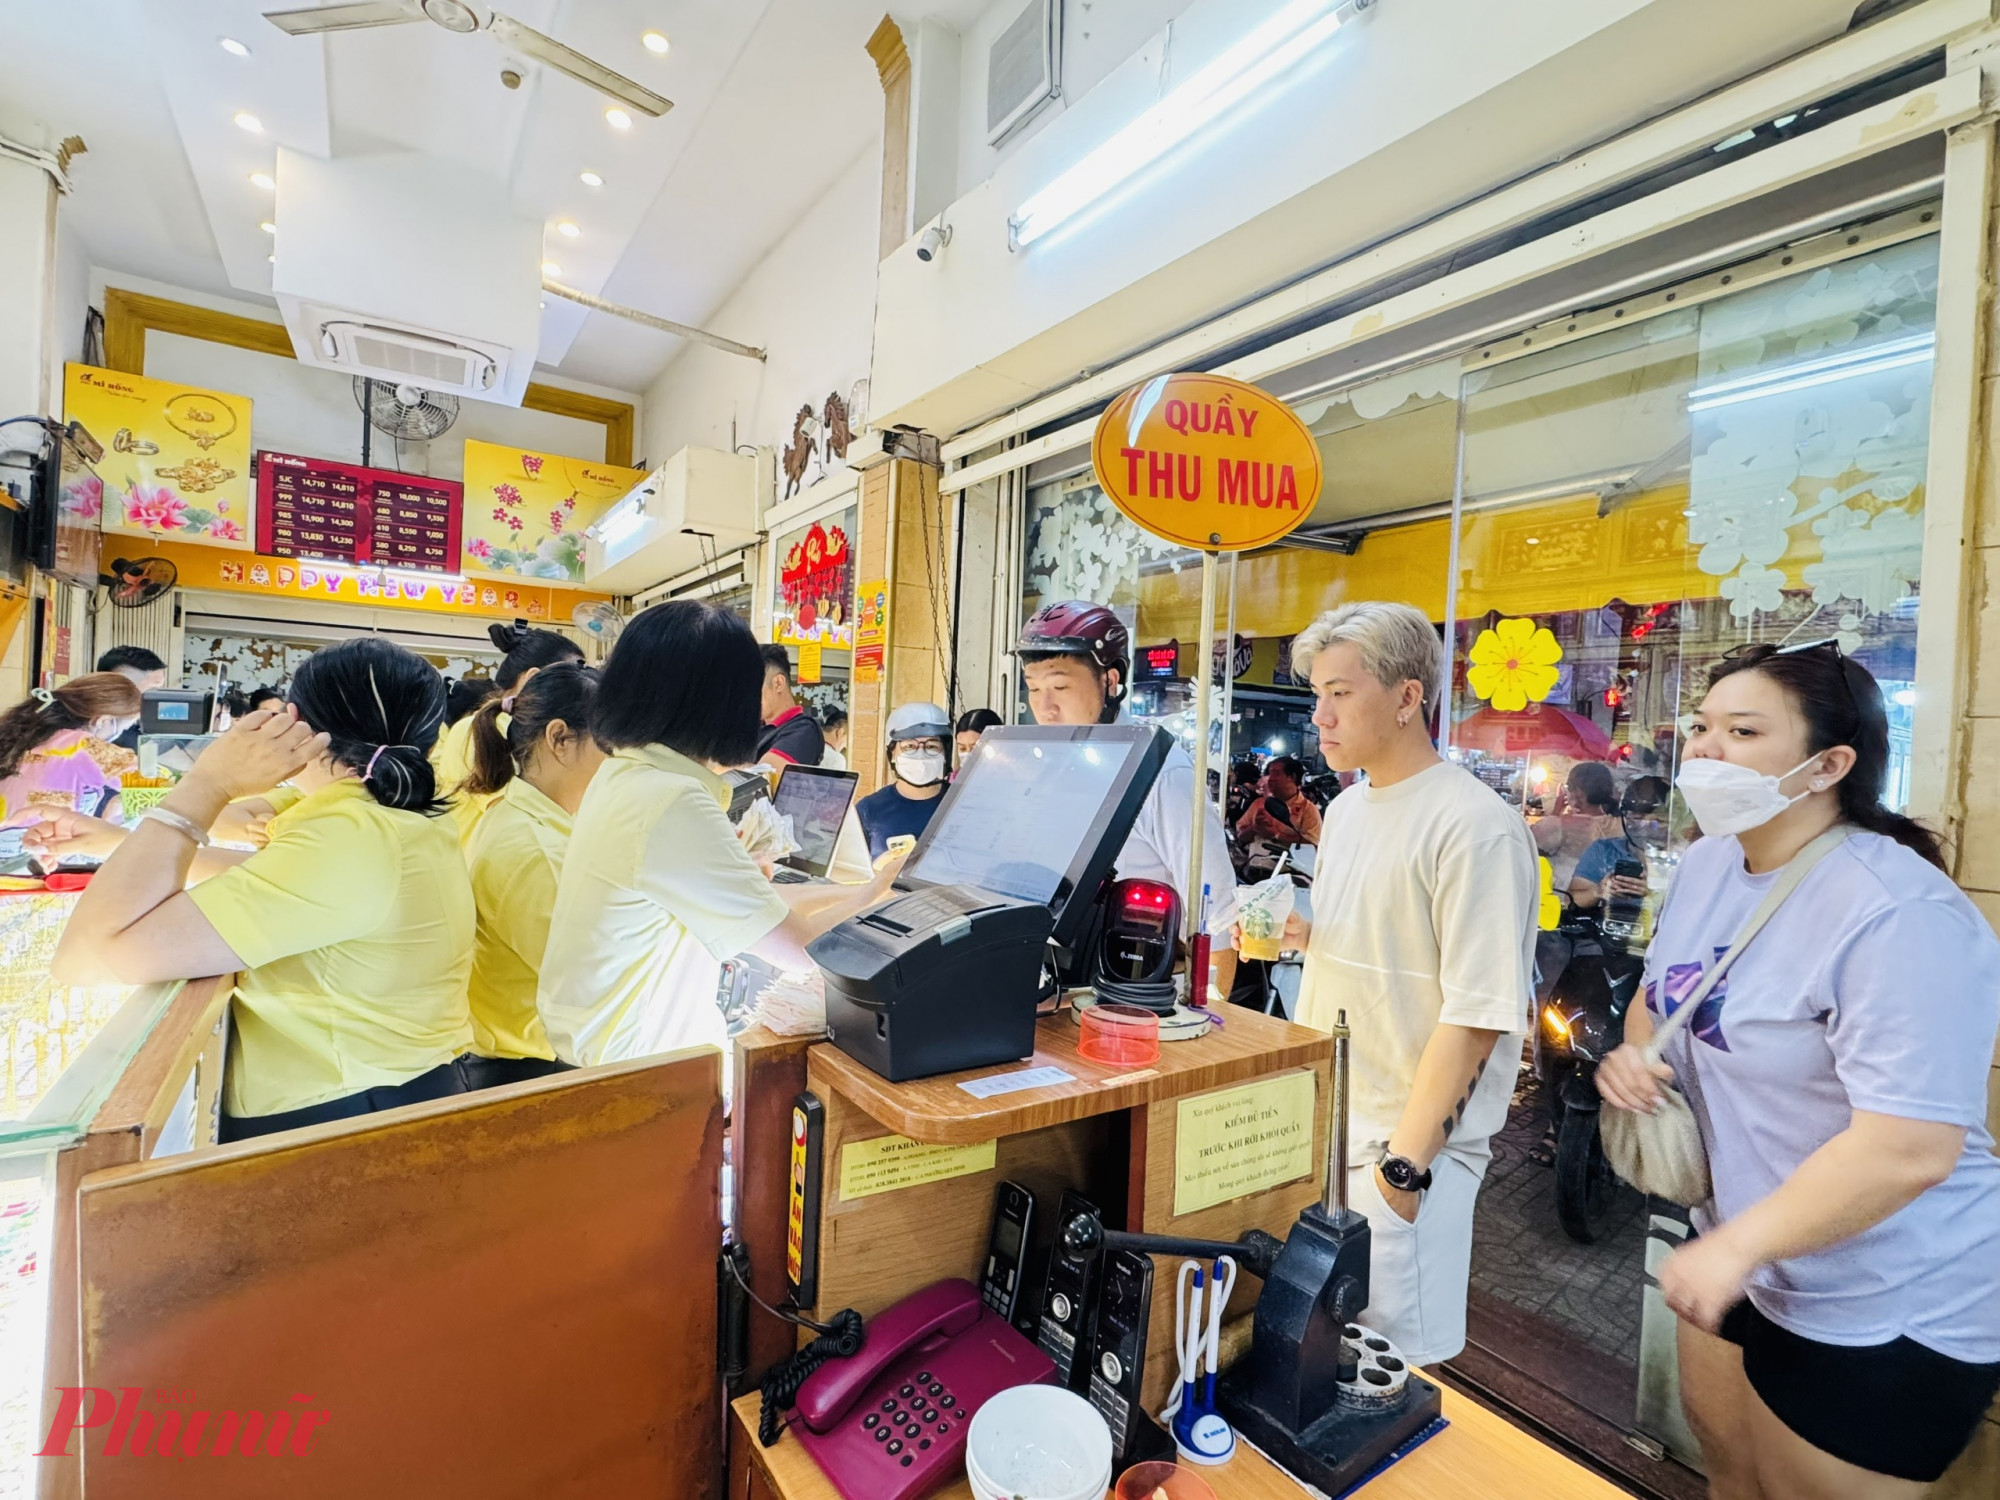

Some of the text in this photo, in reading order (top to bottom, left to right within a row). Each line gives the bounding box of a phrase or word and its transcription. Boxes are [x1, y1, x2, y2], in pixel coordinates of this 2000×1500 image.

[1165, 393, 1258, 437] QUẦY
[1120, 448, 1299, 510] THU MUA
[220, 560, 519, 610] HAPPY NEW YEAR
[1228, 1138, 1242, 1150] KHI
